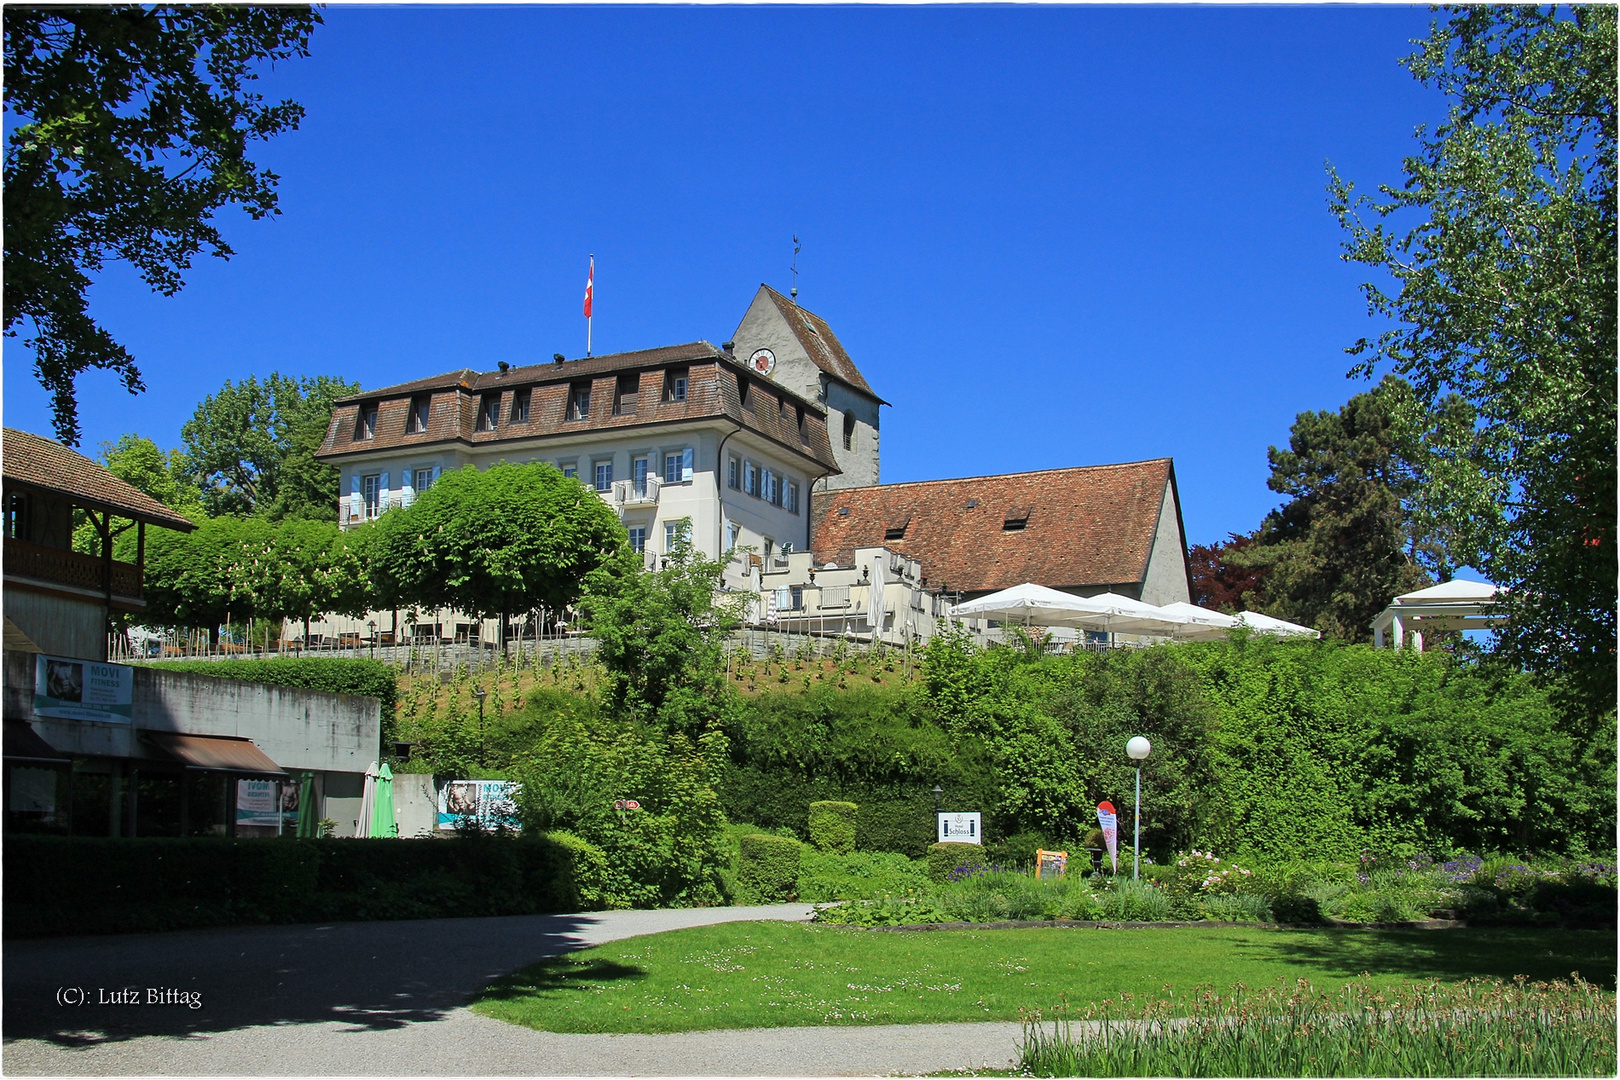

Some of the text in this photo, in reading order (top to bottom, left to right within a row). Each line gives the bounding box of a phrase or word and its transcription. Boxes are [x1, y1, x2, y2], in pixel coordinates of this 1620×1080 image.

[90, 665, 120, 678] MOVI
[90, 677, 120, 688] FITNESS
[949, 828, 969, 836] Schloss
